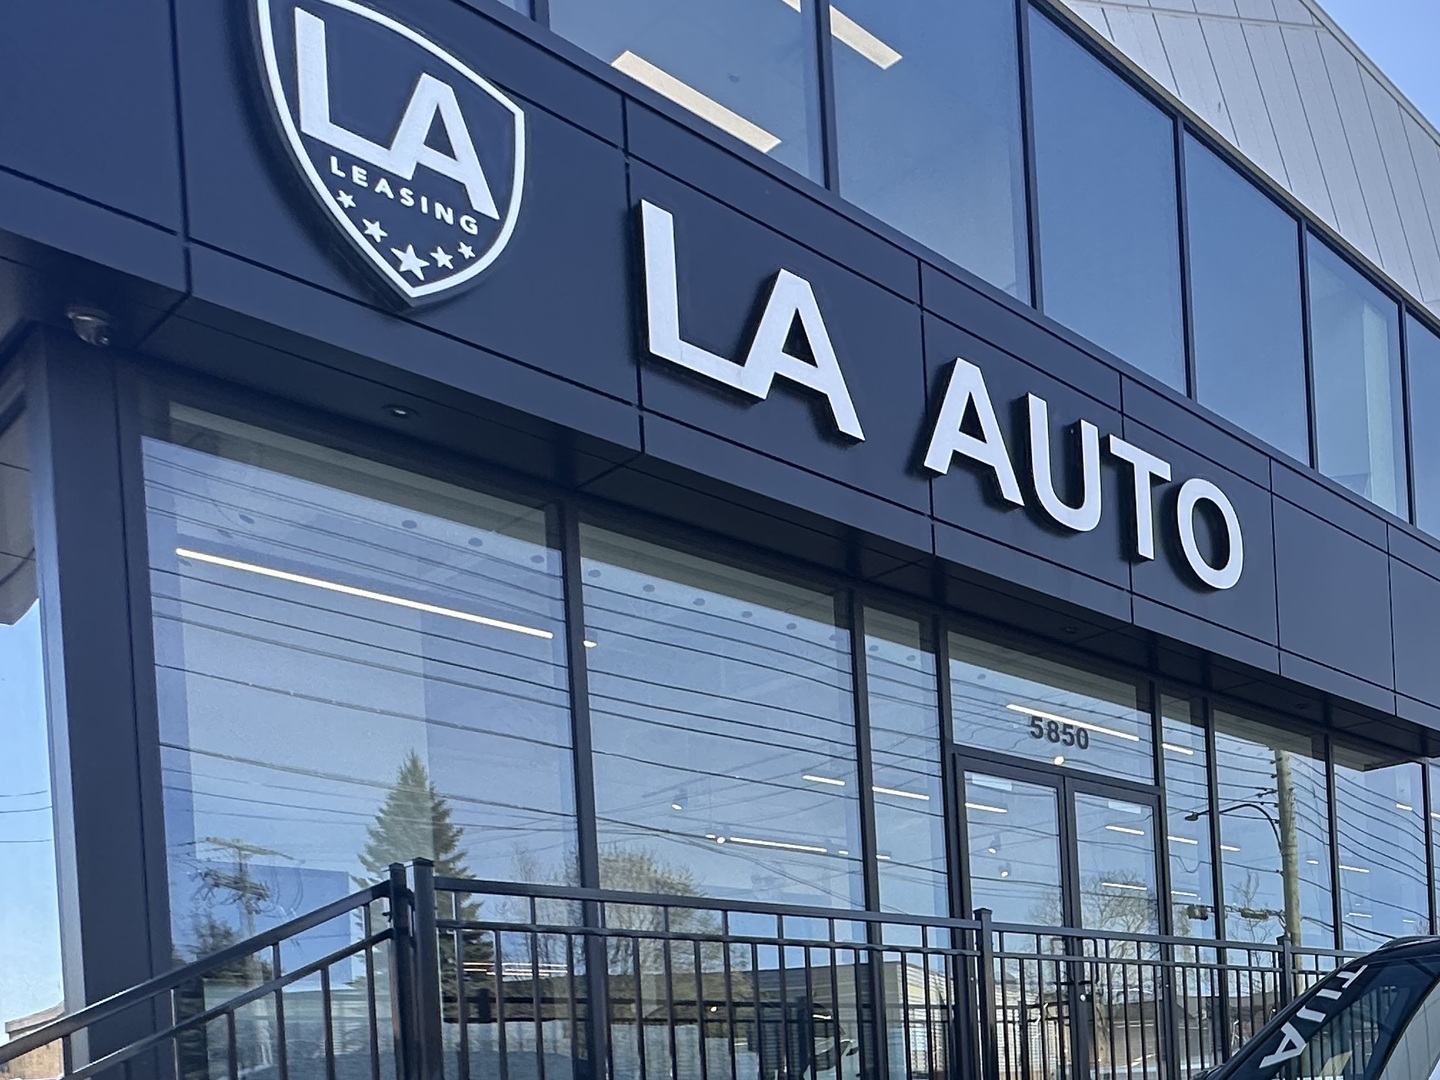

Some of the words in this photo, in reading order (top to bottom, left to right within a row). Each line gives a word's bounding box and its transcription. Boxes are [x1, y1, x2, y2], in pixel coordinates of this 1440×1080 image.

[295, 7, 500, 220] LA
[330, 155, 479, 236] LEASING
[641, 199, 866, 442] LA
[923, 356, 1245, 590] AUTO
[1030, 715, 1089, 750] 5850
